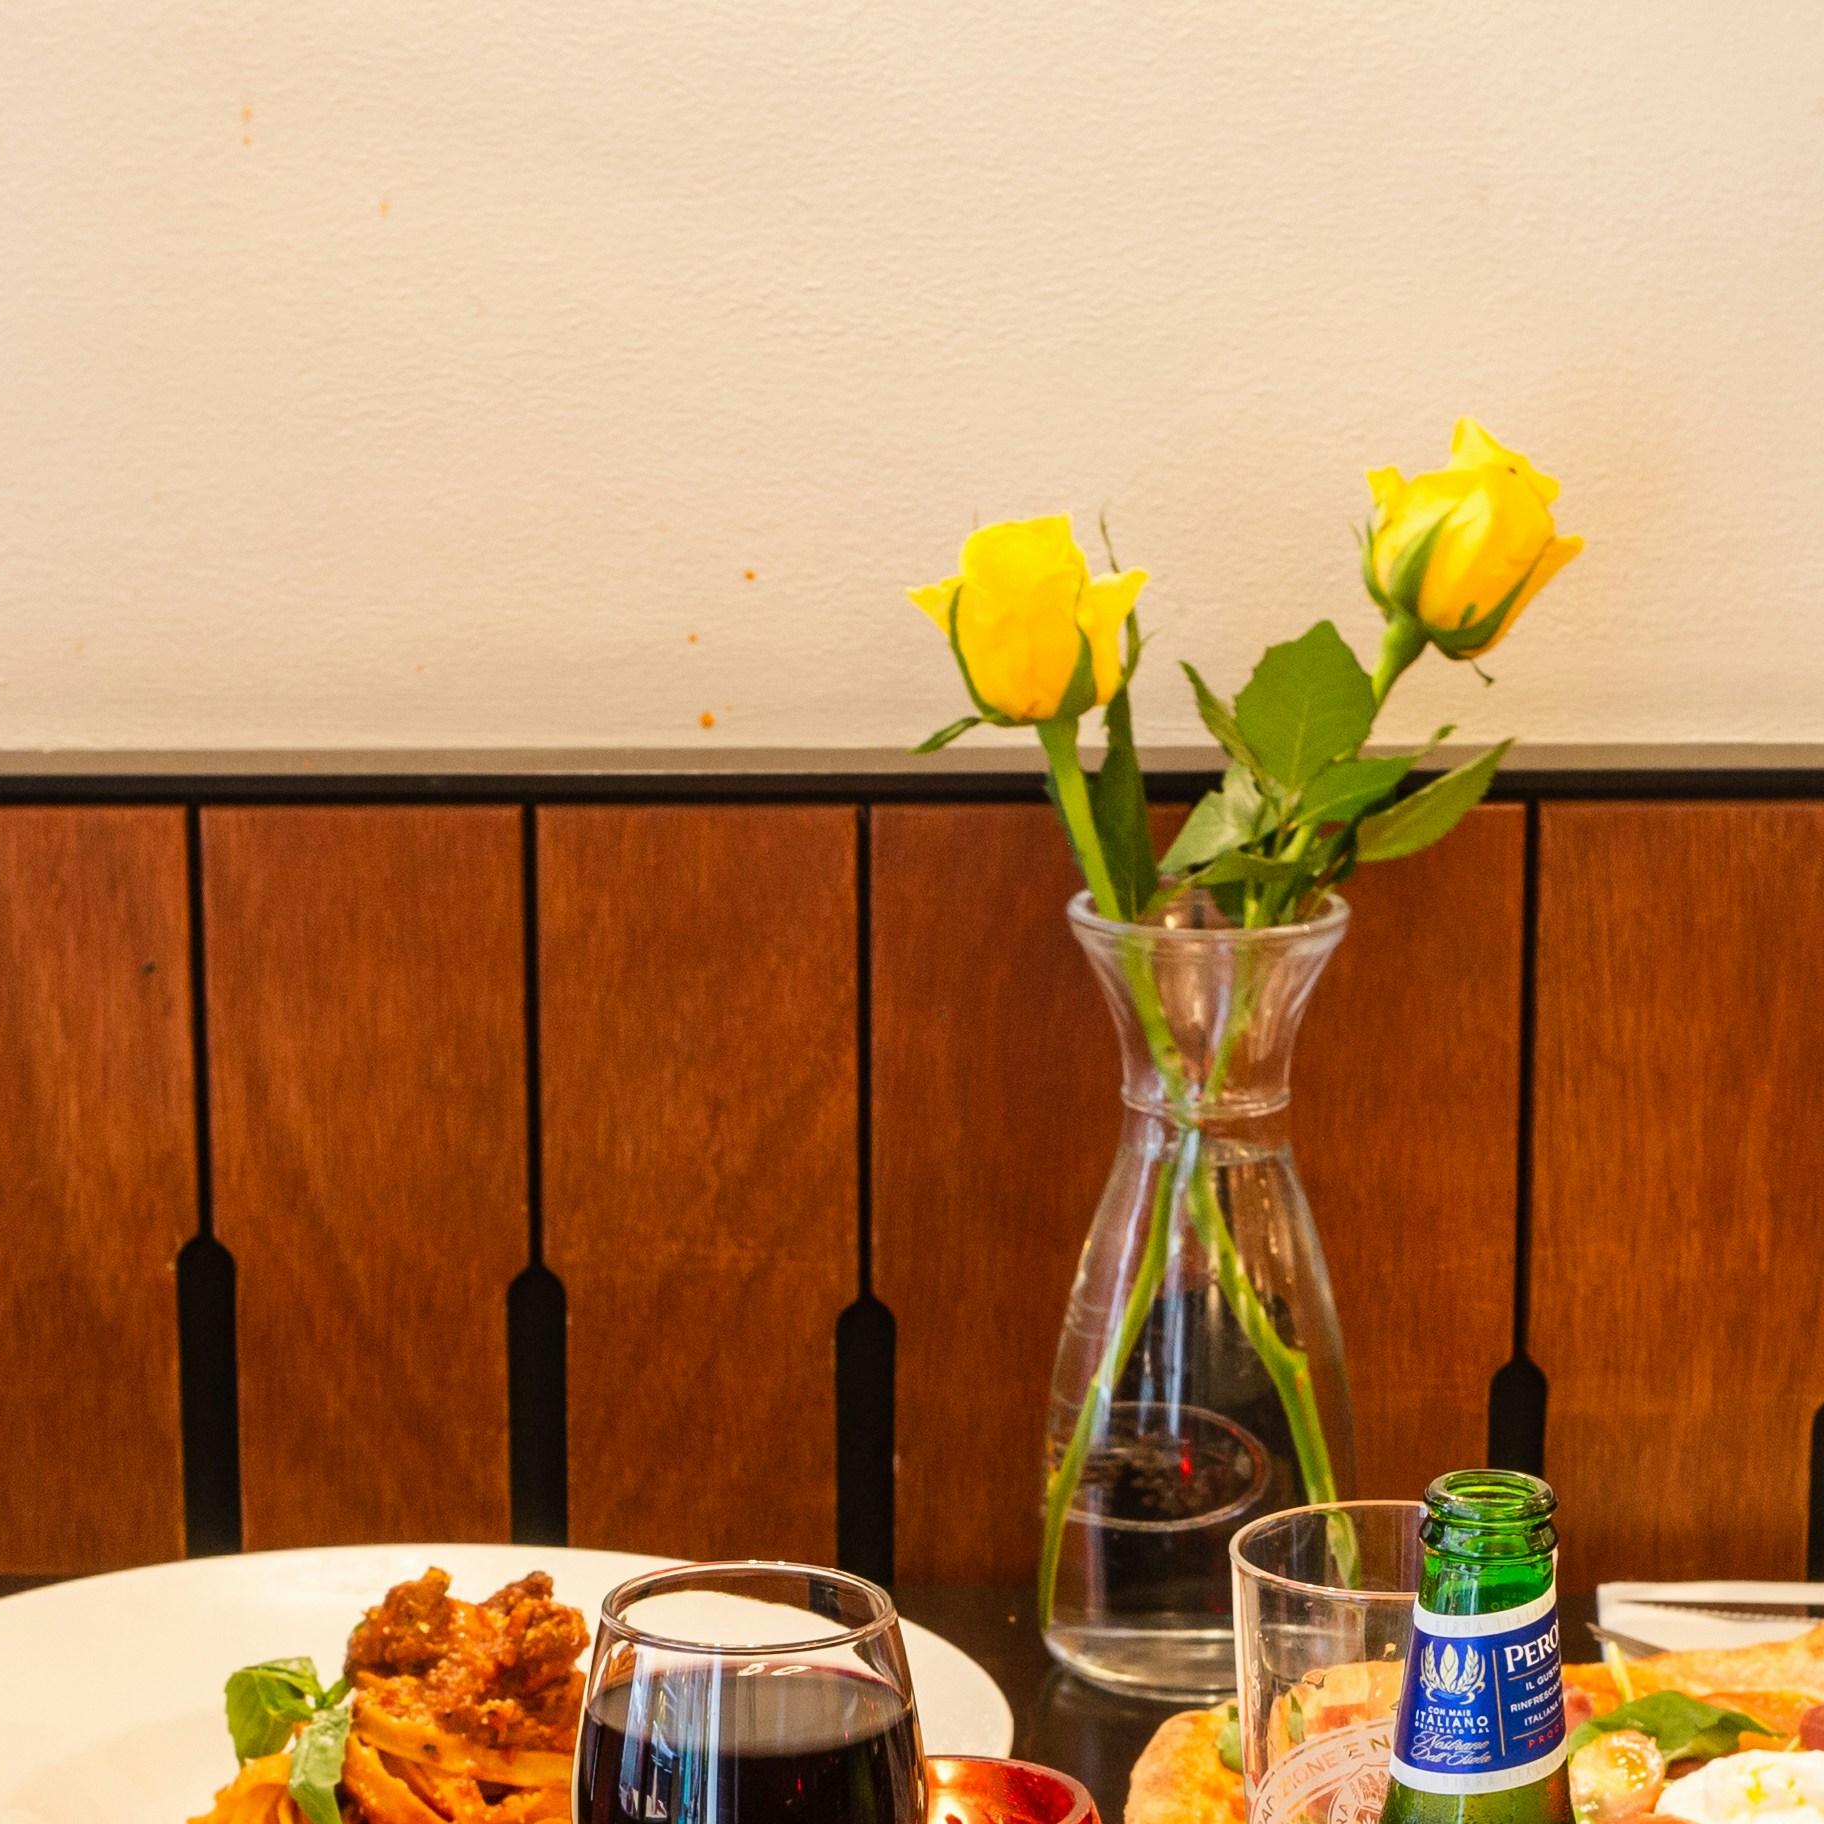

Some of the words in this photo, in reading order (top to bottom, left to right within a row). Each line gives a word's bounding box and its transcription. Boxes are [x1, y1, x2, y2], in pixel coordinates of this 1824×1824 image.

[1504, 1622, 1558, 1673] PERO
[1525, 1681, 1536, 1691] IL
[1428, 1706, 1446, 1715] CON
[1415, 1709, 1488, 1728] ITALIANO
